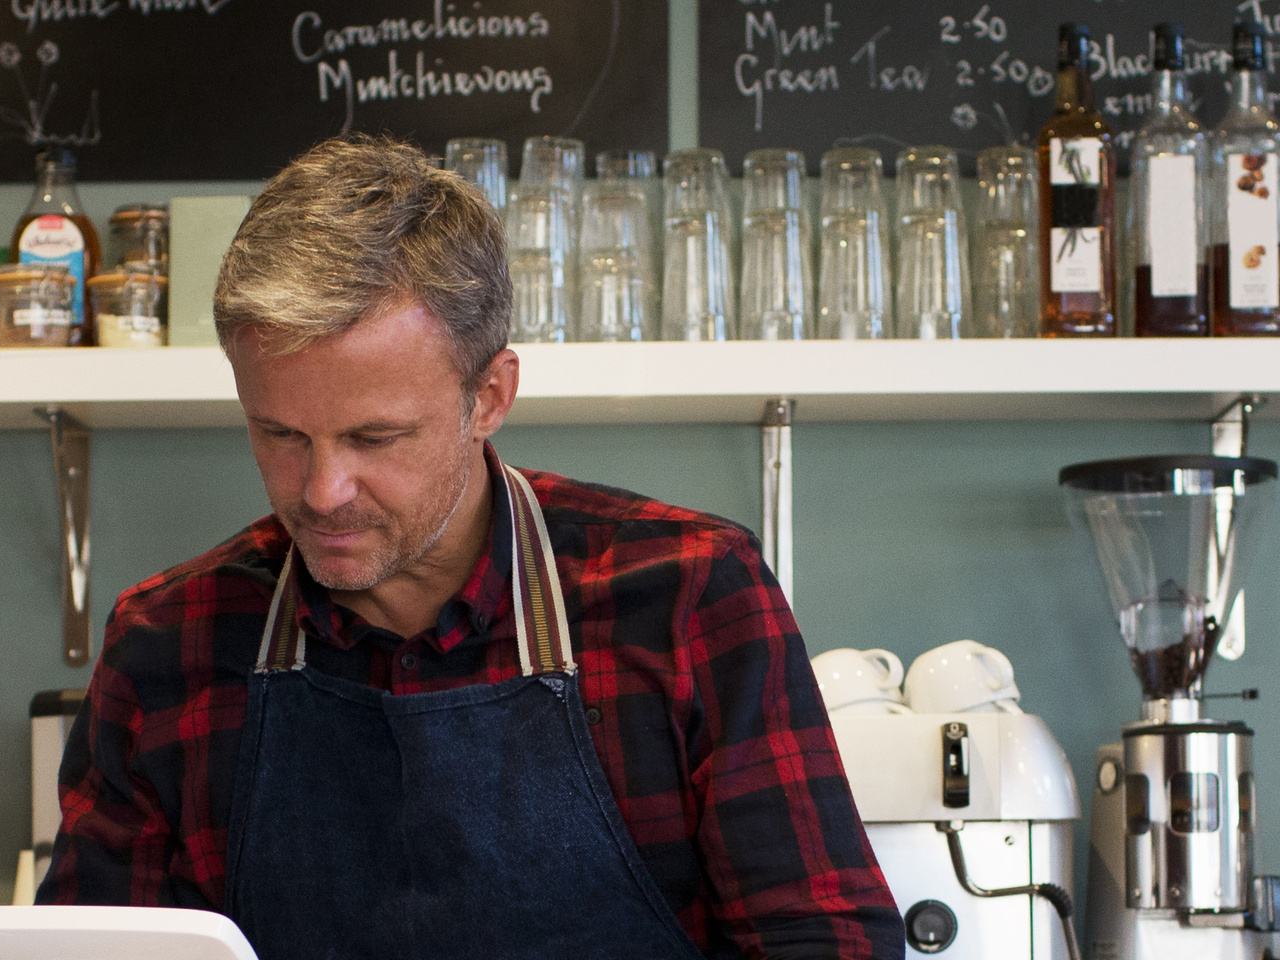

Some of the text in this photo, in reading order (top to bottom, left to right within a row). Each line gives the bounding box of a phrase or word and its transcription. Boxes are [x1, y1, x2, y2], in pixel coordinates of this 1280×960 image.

[291, 0, 550, 63] Caramelicious
[744, 3, 840, 58] Mint
[734, 53, 840, 131] Green
[849, 26, 931, 90] Tea
